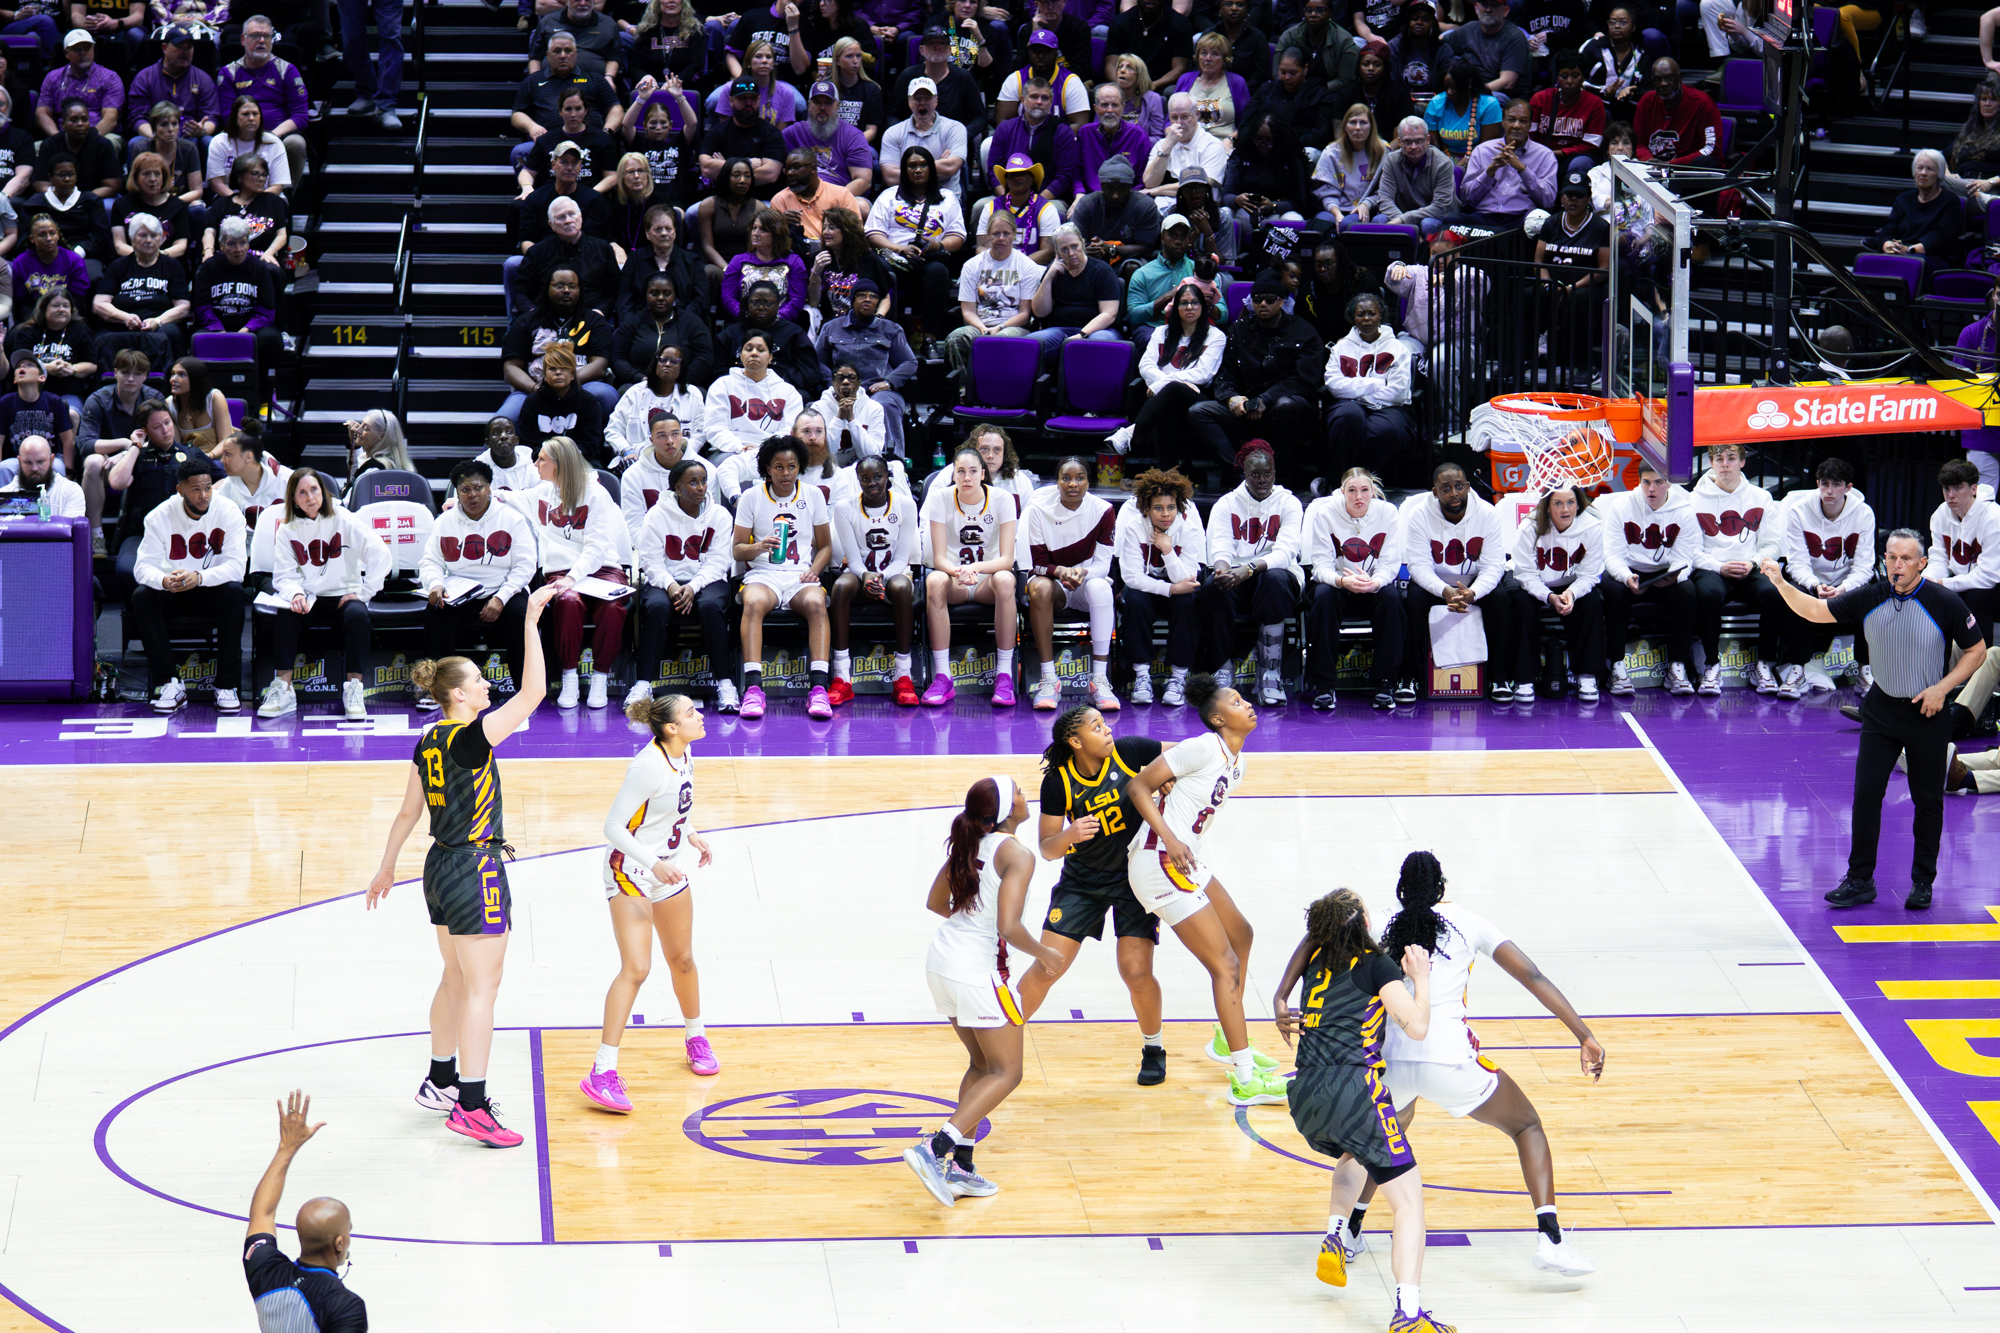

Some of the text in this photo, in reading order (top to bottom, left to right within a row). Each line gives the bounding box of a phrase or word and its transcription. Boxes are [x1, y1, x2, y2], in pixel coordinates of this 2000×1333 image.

[1529, 16, 1551, 33] DEAF
[1538, 113, 1583, 138] CAOLINA
[1559, 245, 1593, 256] CAROLINA
[211, 282, 235, 298] DEAF
[332, 325, 367, 344] 114
[459, 327, 495, 345] 115
[1506, 467, 1519, 482] G
[375, 485, 410, 497] LSU
[385, 519, 411, 527] FRM
[855, 655, 896, 673] Benga
[950, 656, 995, 676] Bengal
[1056, 656, 1088, 676] engal
[1336, 653, 1373, 670] Benga
[1624, 646, 1667, 670] Bengal
[1719, 646, 1757, 667] engal
[1824, 650, 1854, 666] enga
[178, 659, 215, 680] engal
[293, 660, 323, 680] ngal
[377, 667, 410, 684] Beng
[483, 660, 509, 681] enga
[662, 657, 707, 677] Bengal
[761, 657, 804, 677] Bengal
[305, 684, 338, 692] G.O.N.E.
[310, 677, 327, 685] .com
[421, 747, 445, 788] 13
[1085, 788, 1119, 812] LSU
[1094, 806, 1126, 837] 12
[1190, 807, 1213, 835] 8
[668, 816, 687, 850] 5
[482, 870, 502, 925] LSU
[1306, 968, 1332, 1009] 2
[1376, 1102, 1406, 1155] LSU
